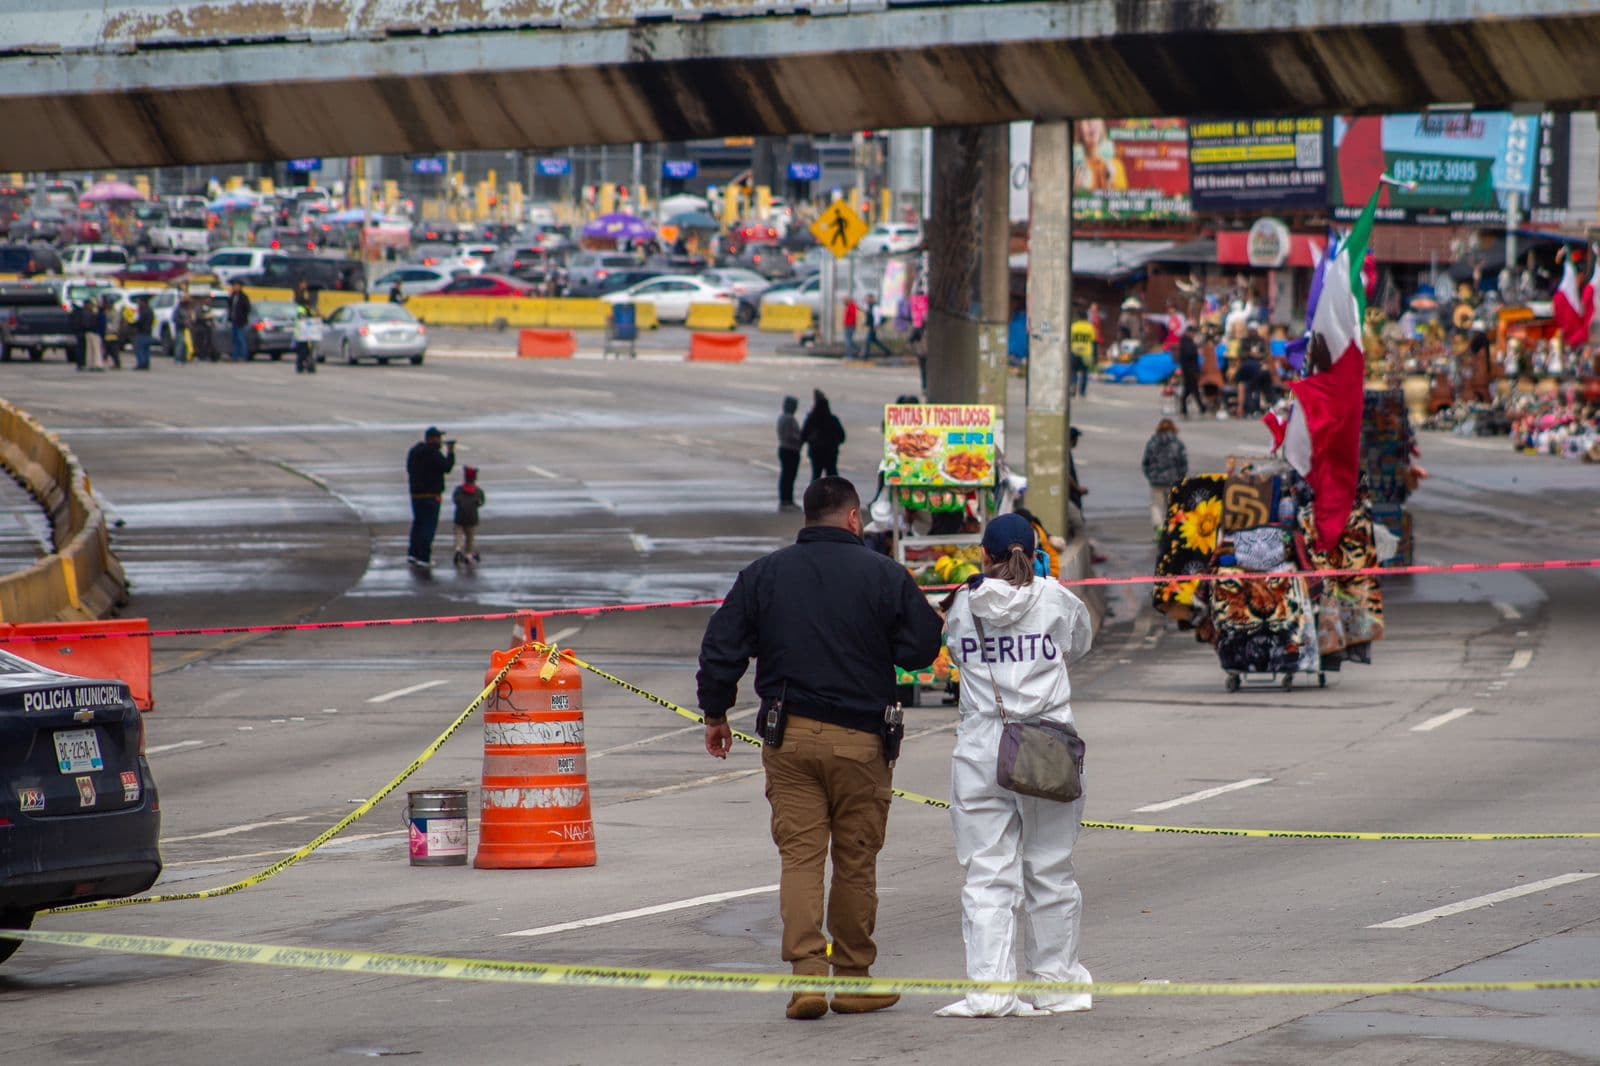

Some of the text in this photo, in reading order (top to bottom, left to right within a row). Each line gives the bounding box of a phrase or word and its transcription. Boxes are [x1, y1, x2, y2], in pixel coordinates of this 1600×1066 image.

[887, 407, 991, 426] FRUTAS Y TOSTILOCOS
[948, 432, 994, 445] ERI
[961, 633, 1057, 663] PERITO
[75, 686, 123, 706] MUNICIPAL
